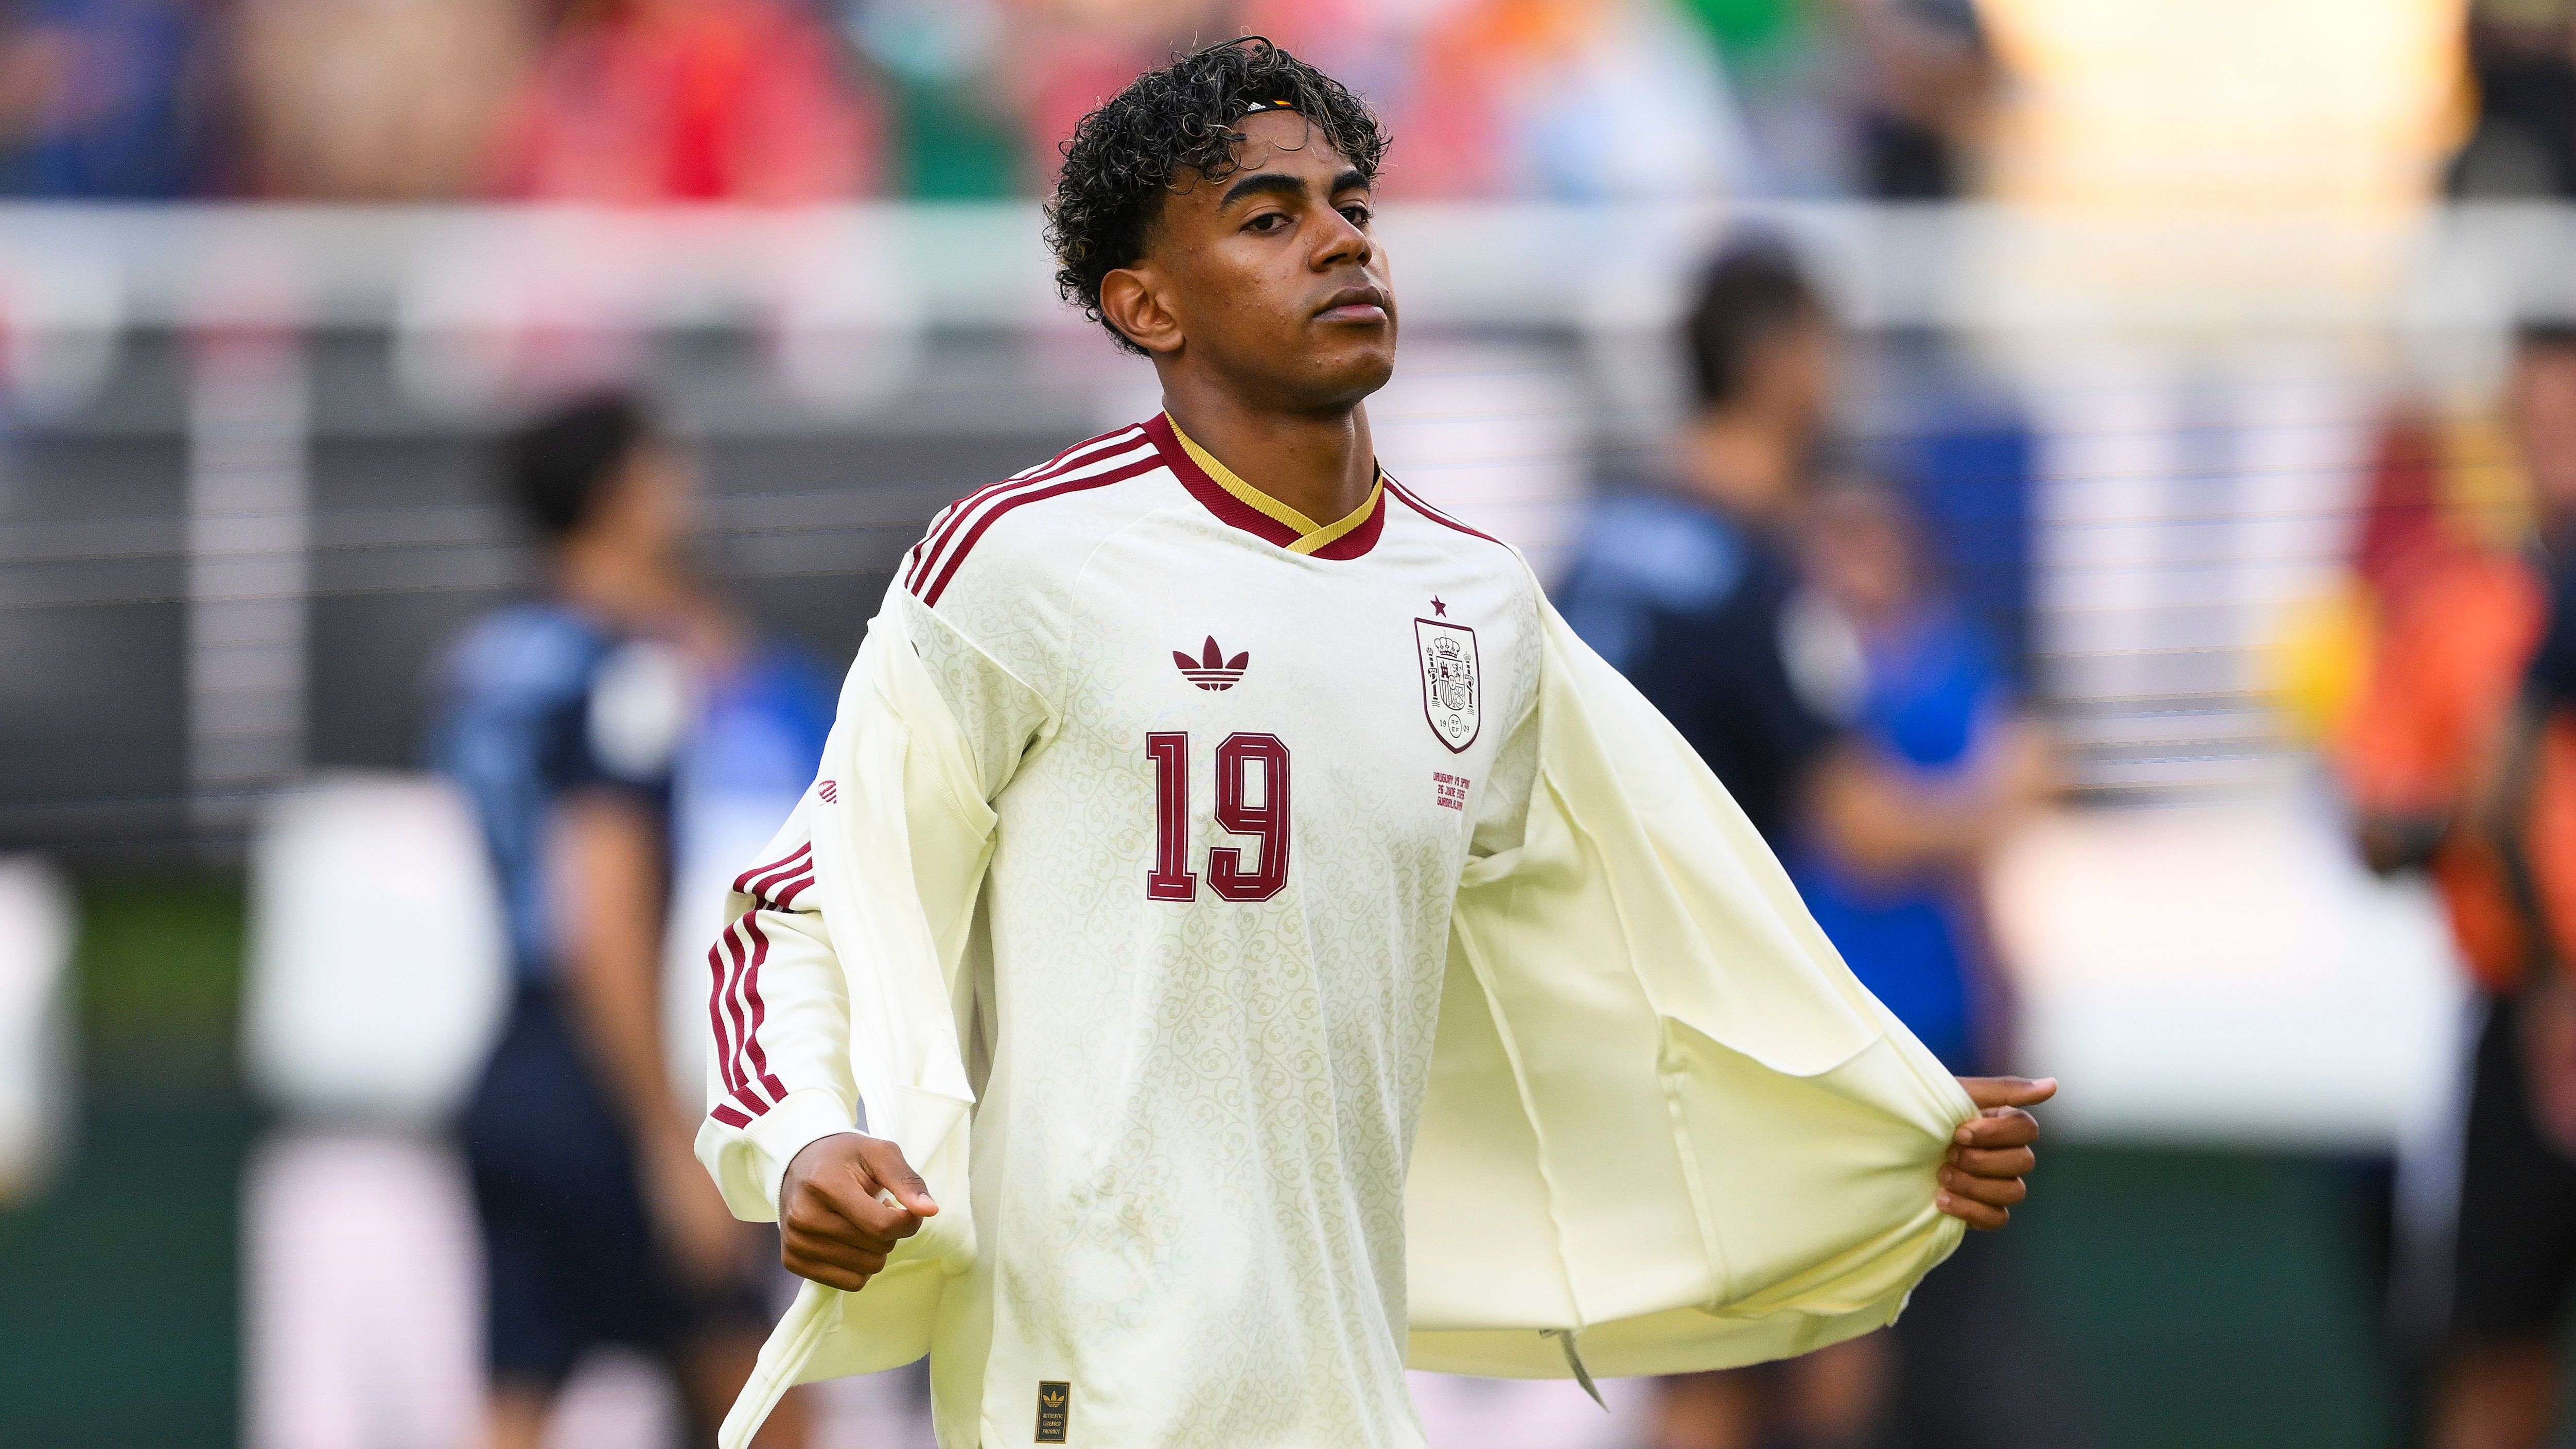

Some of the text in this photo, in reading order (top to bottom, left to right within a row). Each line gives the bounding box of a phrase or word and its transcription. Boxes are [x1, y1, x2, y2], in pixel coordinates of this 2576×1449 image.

[1433, 772, 1470, 789] URUGUAY VS SPA
[1438, 784, 1444, 794] 26
[1445, 786, 1456, 797] JUNE
[1437, 796, 1462, 811] GUADALAJ
[1146, 731, 1290, 902] 19
